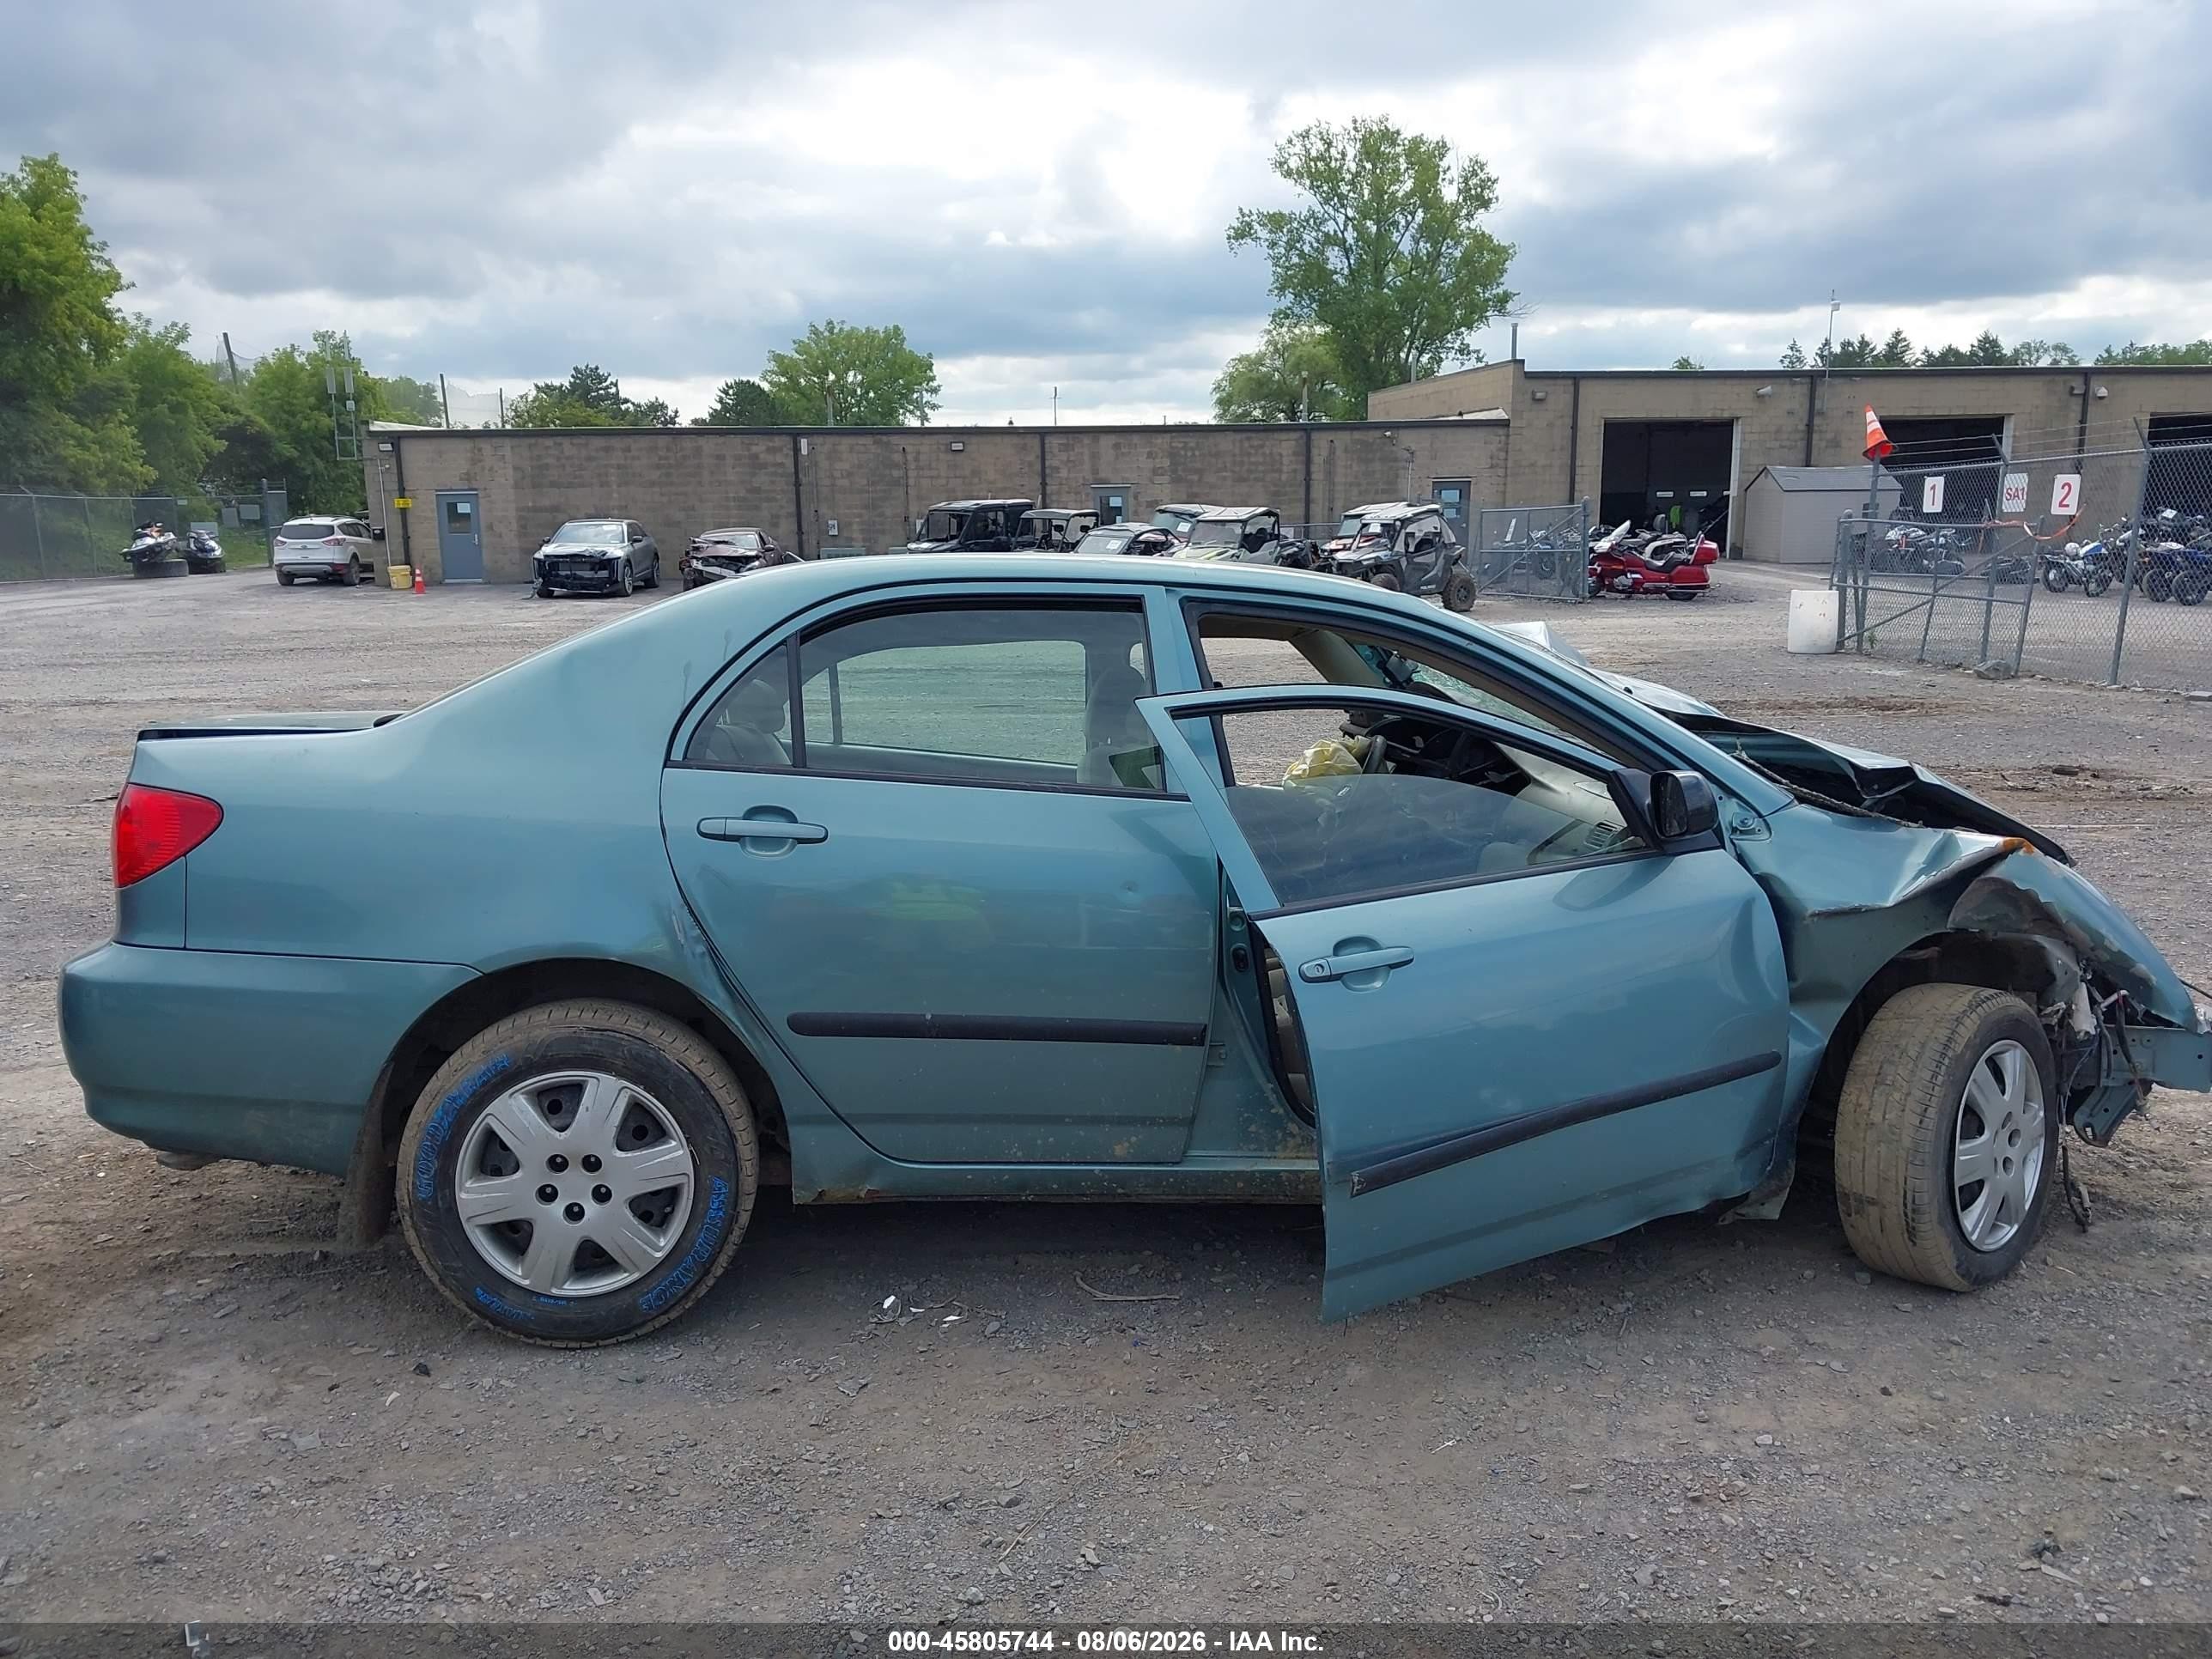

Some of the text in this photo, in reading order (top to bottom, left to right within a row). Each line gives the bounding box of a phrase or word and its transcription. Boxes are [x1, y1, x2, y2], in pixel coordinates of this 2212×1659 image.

[1929, 483, 1937, 507] 1
[2057, 482, 2072, 508] 2
[639, 1176, 729, 1313] ASSURANCE
